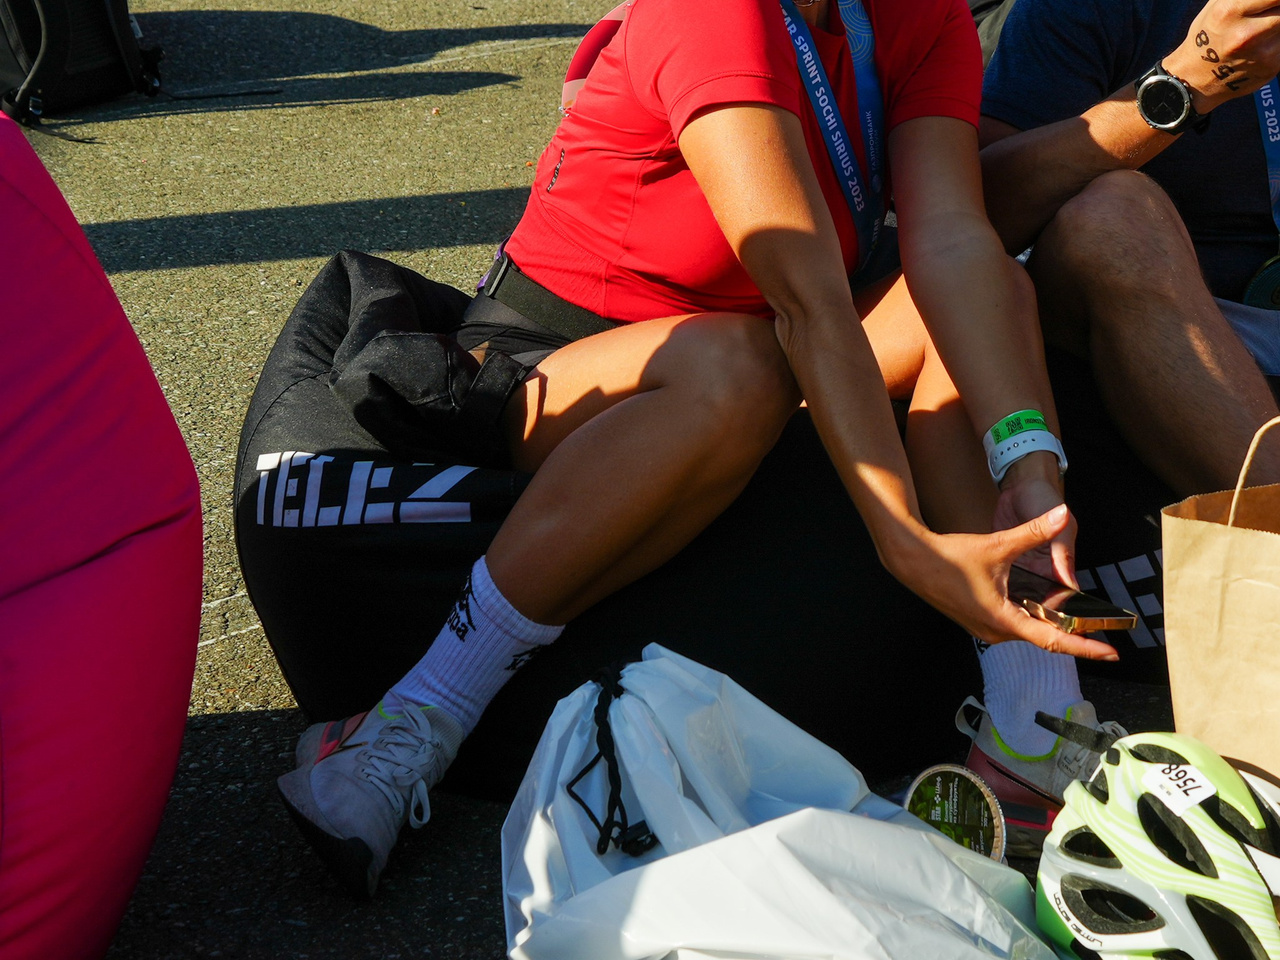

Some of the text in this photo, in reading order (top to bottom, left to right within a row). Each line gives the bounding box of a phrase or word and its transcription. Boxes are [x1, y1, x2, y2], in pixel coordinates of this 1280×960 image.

[794, 34, 822, 85] SPRINT
[814, 85, 838, 132] SOCHI
[831, 130, 854, 177] SIRIUS
[848, 175, 865, 213] 2023
[865, 109, 877, 171] ГАЗПРОМБАНК
[1264, 109, 1280, 142] 2023
[1161, 764, 1206, 797] 7568
